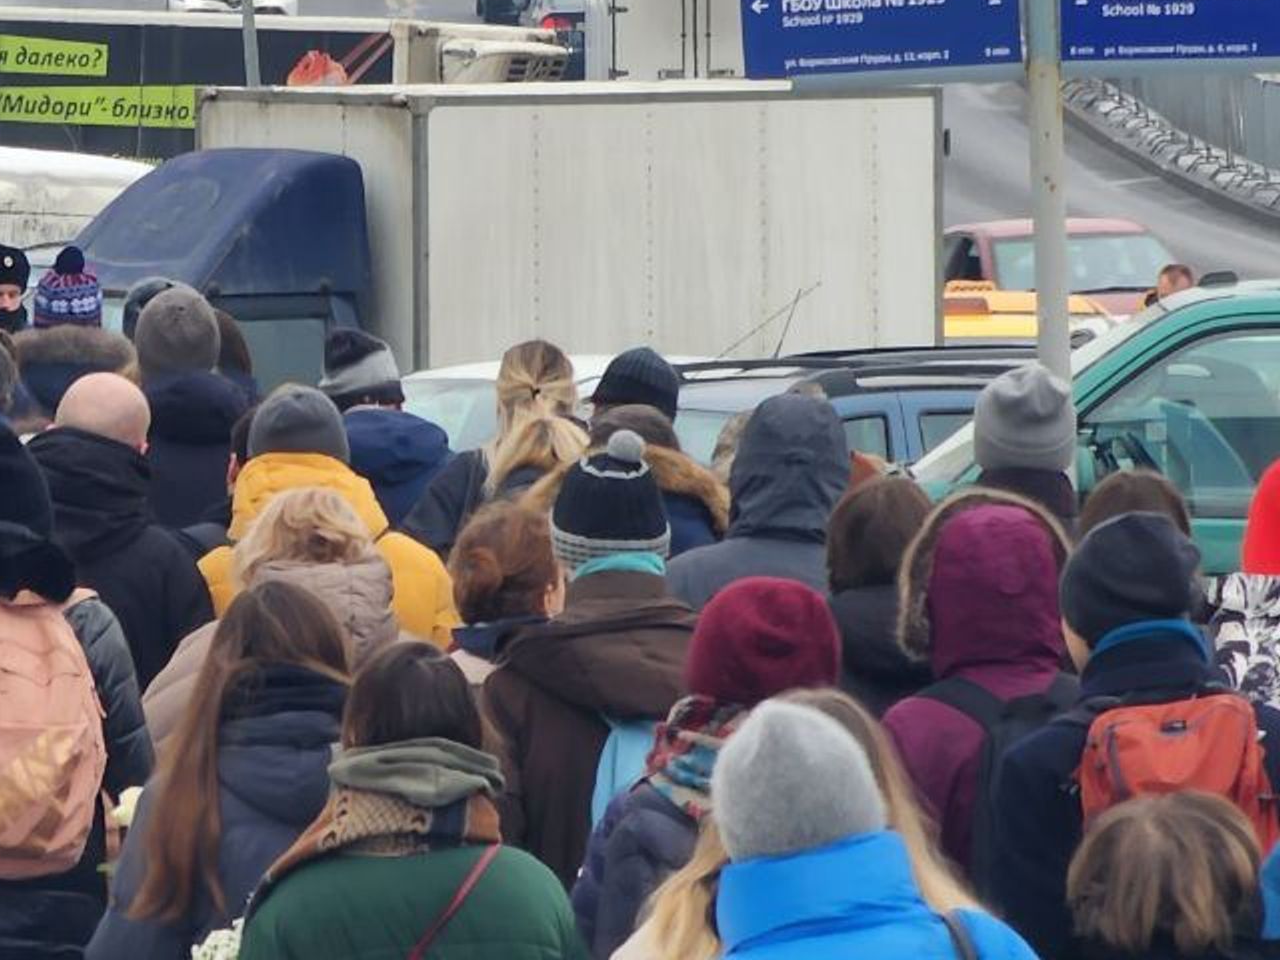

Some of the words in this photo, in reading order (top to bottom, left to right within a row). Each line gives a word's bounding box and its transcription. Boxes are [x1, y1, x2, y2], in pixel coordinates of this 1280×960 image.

[1101, 3, 1144, 17] School
[782, 14, 821, 28] School
[14, 45, 104, 70] далеко?
